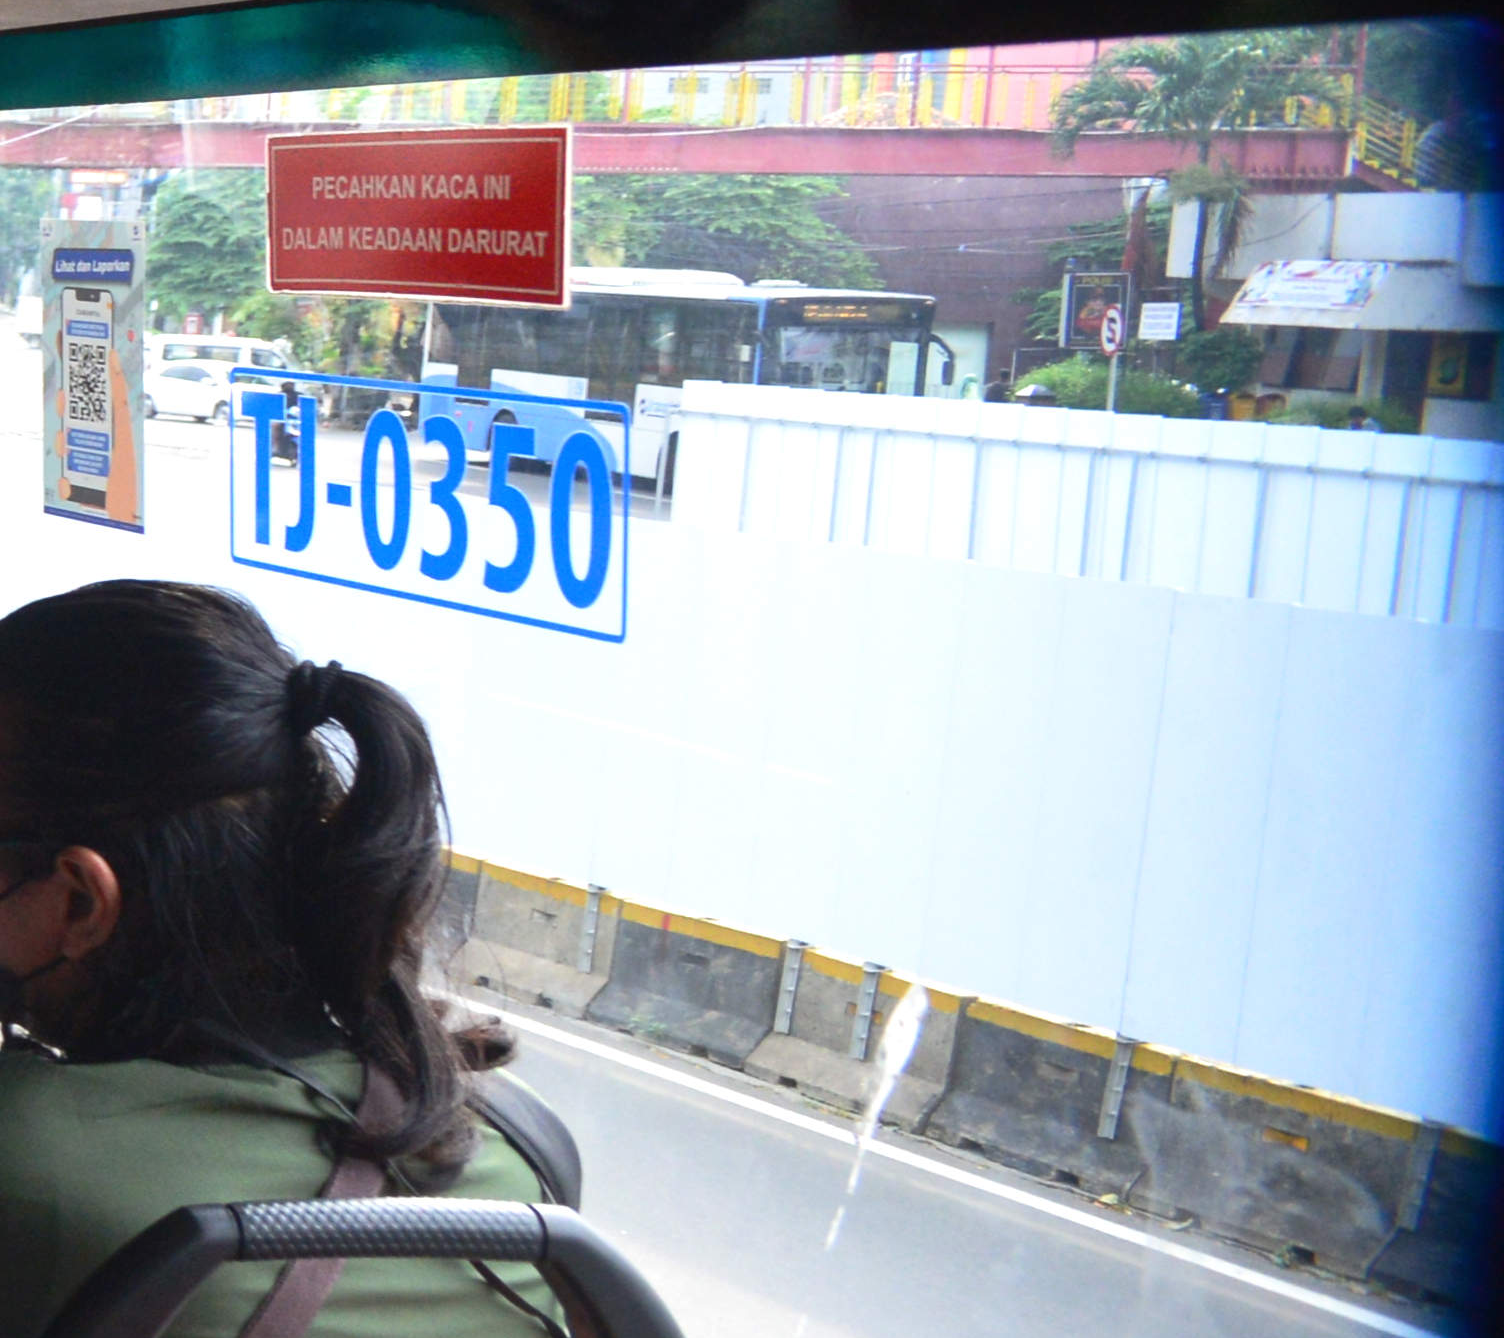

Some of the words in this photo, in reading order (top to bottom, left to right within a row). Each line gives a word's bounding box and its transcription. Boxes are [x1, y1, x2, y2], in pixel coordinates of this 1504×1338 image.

[312, 175, 416, 200] PECAHKAN
[421, 174, 480, 201] KACA
[484, 174, 511, 201] INI
[283, 227, 343, 251] DALAM
[349, 227, 441, 254] KEADAAN
[448, 230, 548, 258] DARURAT
[55, 259, 75, 273] Lihat
[77, 259, 91, 273] dan
[92, 259, 130, 275] Laporkan
[242, 391, 612, 609] TJ-0350
